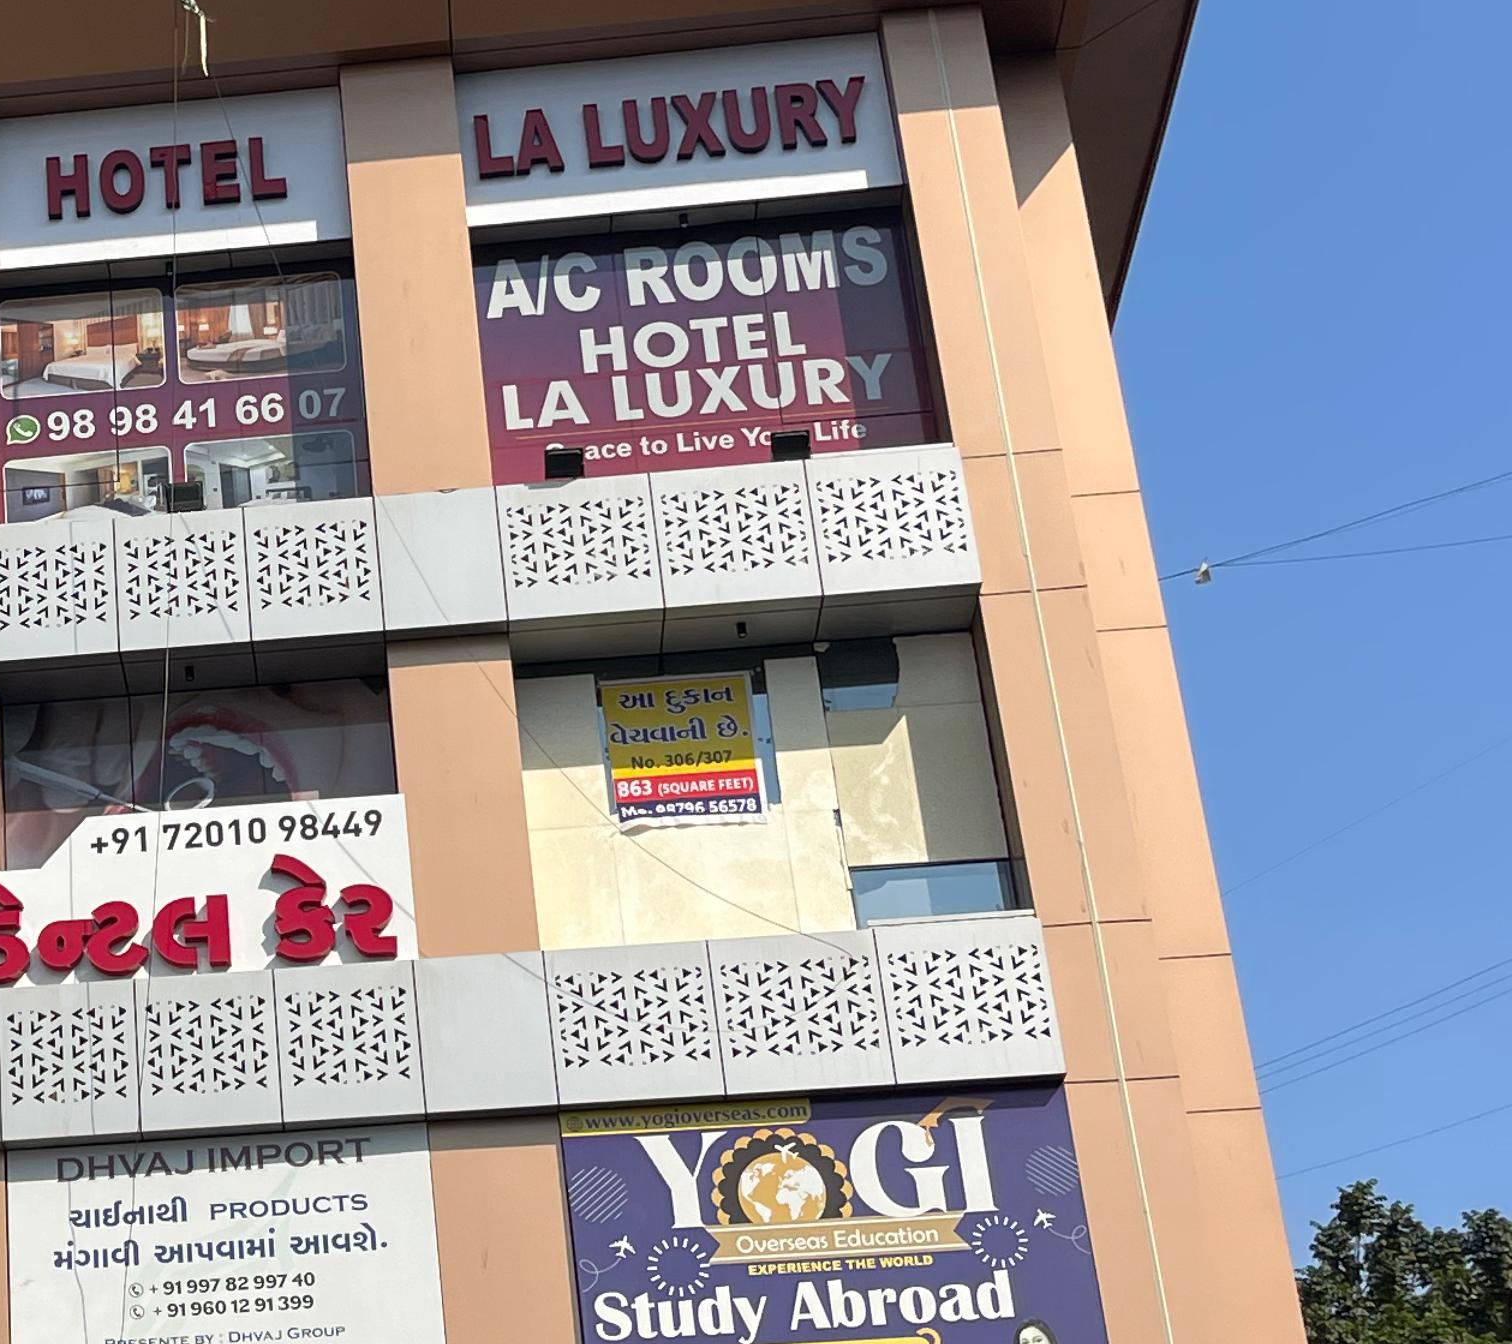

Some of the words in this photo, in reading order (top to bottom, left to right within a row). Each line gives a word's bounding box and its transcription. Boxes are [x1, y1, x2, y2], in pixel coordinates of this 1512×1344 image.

[473, 108, 565, 180] LA
[583, 76, 865, 169] LUXURY
[45, 136, 288, 221] HOTEL
[487, 251, 602, 319] A/C
[622, 225, 888, 308] ROOMS
[579, 311, 807, 374] HOTEL
[502, 379, 590, 431] LA
[612, 353, 893, 422] LUXURY
[618, 691, 655, 709] આ
[665, 686, 733, 714] દુકાન
[717, 715, 749, 738] છે.
[631, 756, 660, 770] No.
[664, 750, 733, 768] 306/307
[617, 780, 652, 798] 863
[658, 779, 715, 797] (SQUARE
[718, 777, 754, 791] FEET)
[709, 798, 758, 813] 56578
[90, 825, 148, 854] +91
[162, 817, 266, 850] 72010
[278, 809, 383, 840] 98449
[270, 854, 398, 962] કેર
[584, 1102, 809, 1130] www.yogioverseas.com
[56, 1150, 196, 1184] DHVAJ
[208, 1136, 371, 1174] IMPORT
[70, 1196, 188, 1228] ચાઈનાથી
[210, 1193, 369, 1221] PRODUCTS
[54, 1239, 140, 1271] મંગાવી
[154, 1227, 276, 1265] આપવામાં
[290, 1221, 388, 1255] આવશે.
[735, 1232, 828, 1255] Overseas
[833, 1223, 939, 1249] Education
[747, 1259, 842, 1277] EXPERIENCE
[845, 1257, 868, 1271] THE
[872, 1254, 934, 1269] WORLD
[594, 1282, 768, 1344] Study
[790, 1270, 1016, 1332] Abroad
